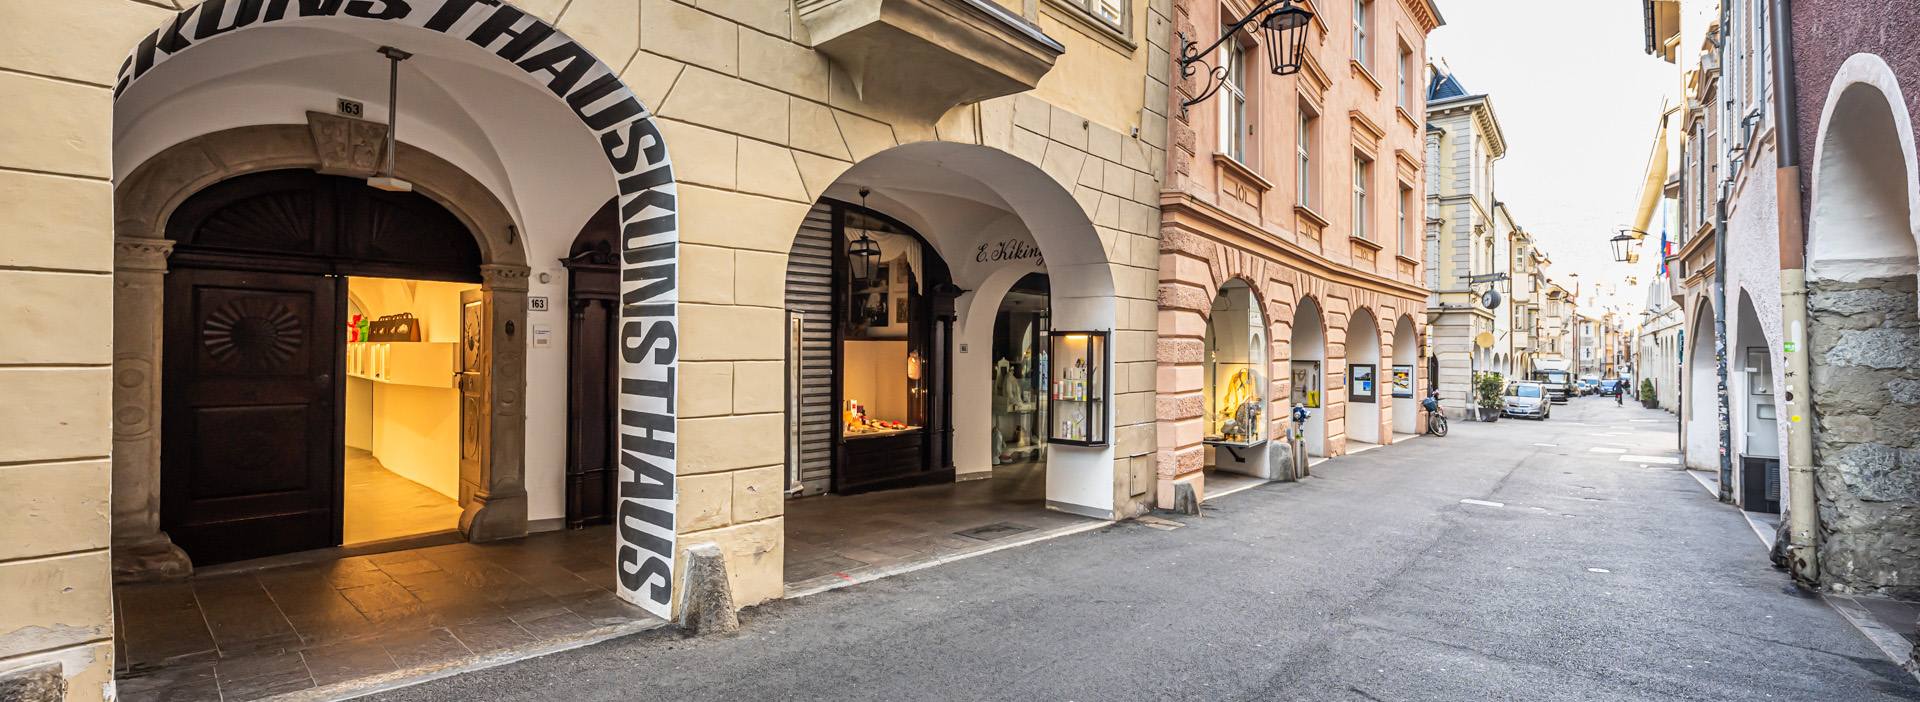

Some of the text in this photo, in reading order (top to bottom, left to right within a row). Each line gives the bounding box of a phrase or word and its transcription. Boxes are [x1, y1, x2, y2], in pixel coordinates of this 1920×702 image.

[340, 101, 360, 115] 163
[976, 243, 988, 262] E.
[531, 299, 544, 308] 163
